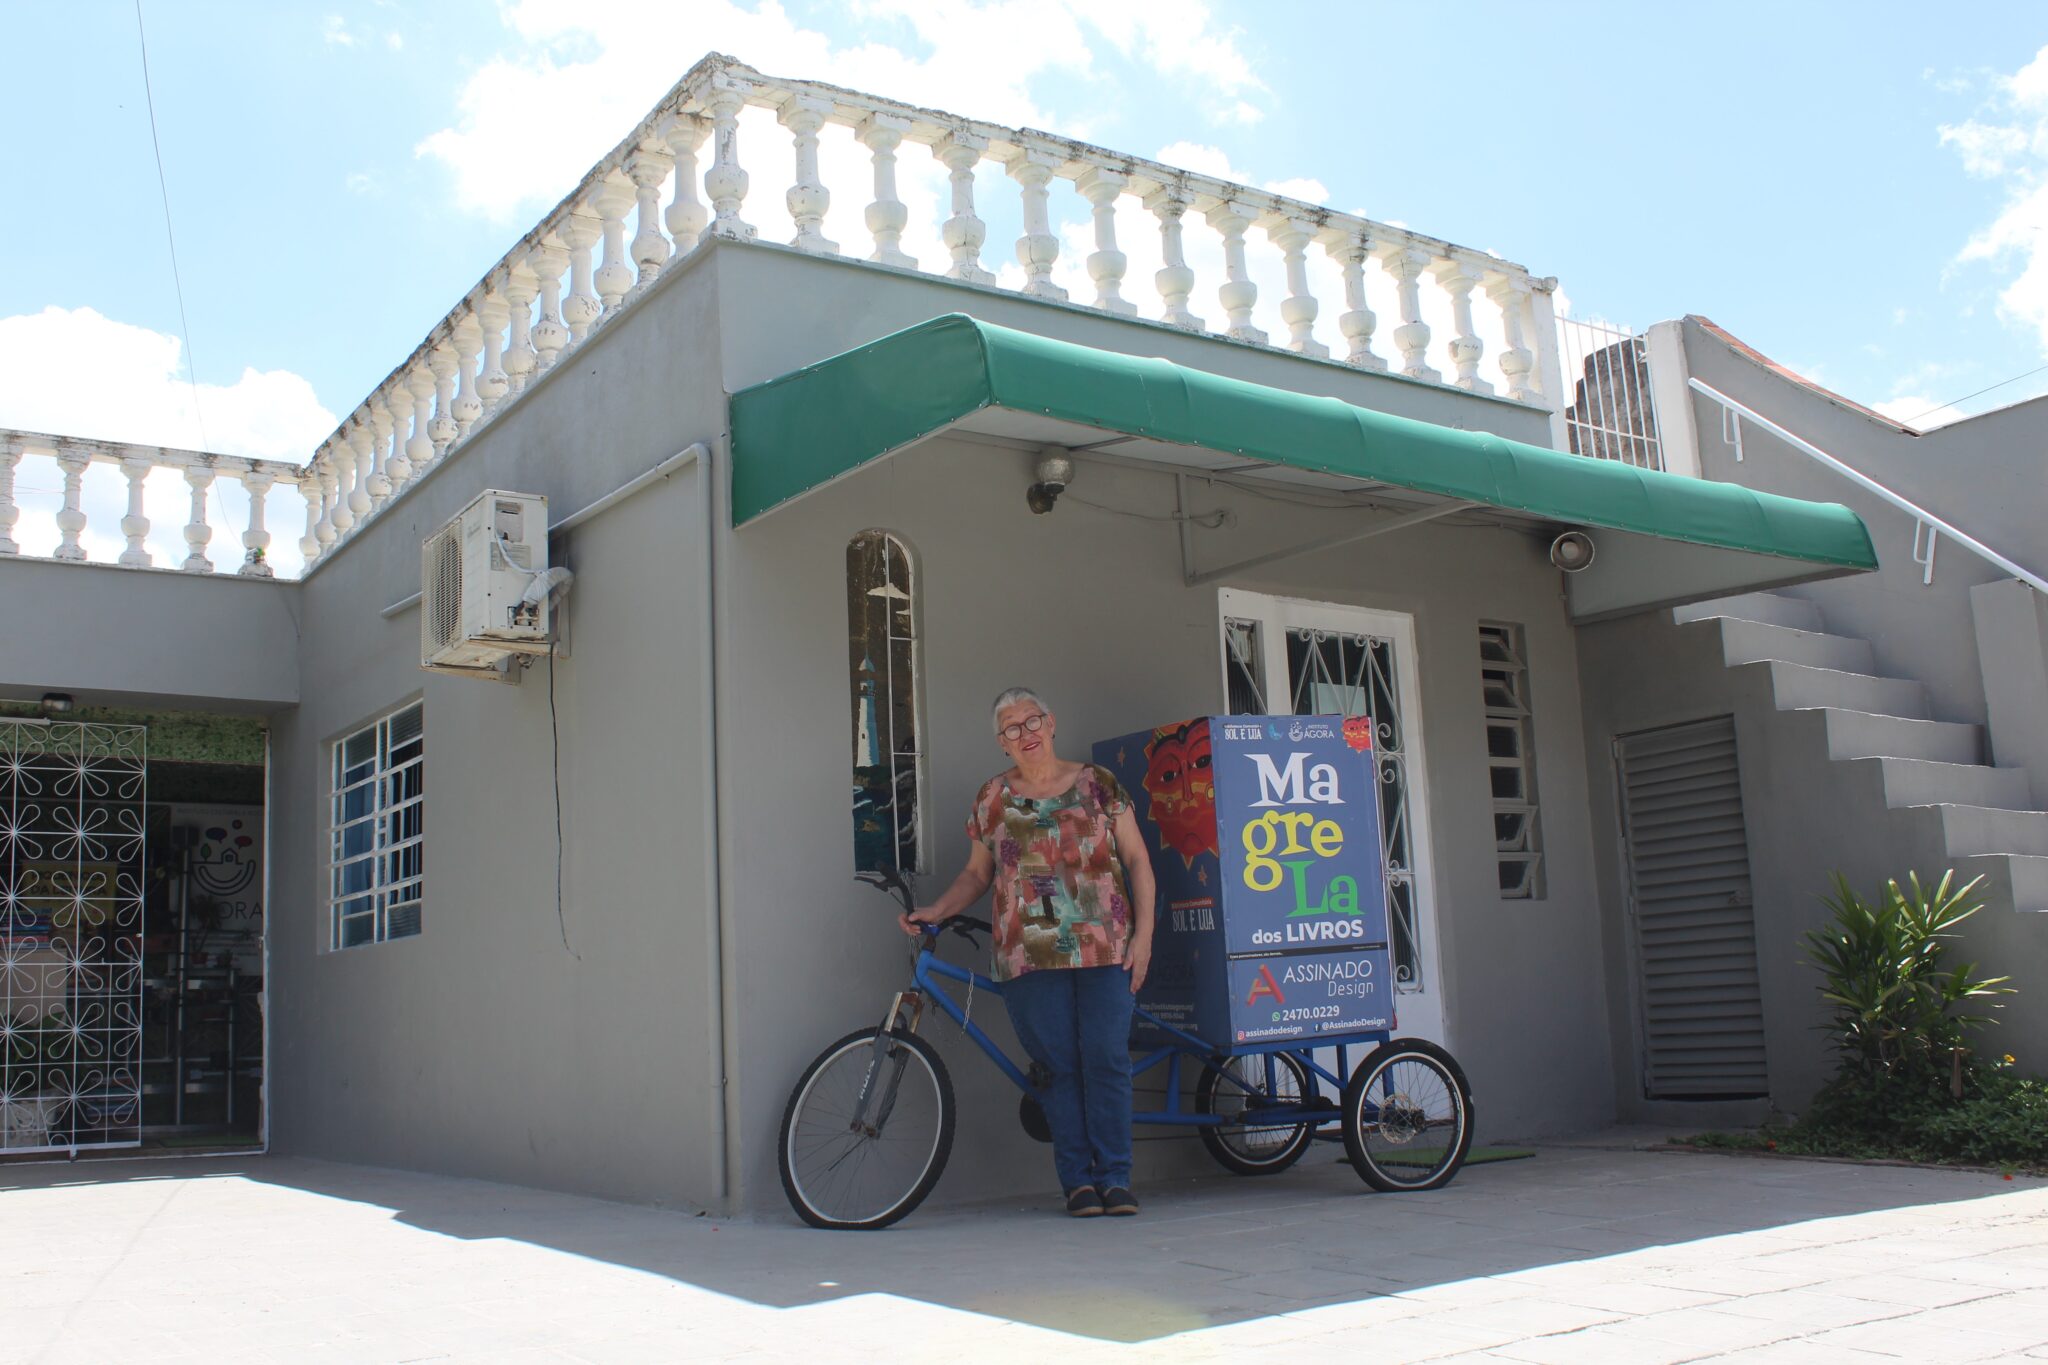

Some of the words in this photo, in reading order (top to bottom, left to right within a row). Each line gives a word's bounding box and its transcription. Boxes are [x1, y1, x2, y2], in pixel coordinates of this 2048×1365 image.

[1224, 728, 1238, 740] SOL
[1240, 728, 1246, 740] E
[1248, 728, 1262, 740] LUA
[1304, 728, 1334, 739] ÁGORA
[1243, 752, 1346, 807] Ma
[1242, 810, 1344, 891] gre
[1280, 860, 1366, 917] La
[1172, 910, 1188, 932] SOL
[1190, 909, 1196, 931] E
[1198, 908, 1215, 930] LUA
[1252, 929, 1282, 944] dos
[1286, 919, 1364, 942] LIVROS
[1283, 960, 1373, 984] ASSINADO
[1328, 979, 1374, 999] Design
[1282, 1005, 1340, 1022] 2470.0229
[1322, 1017, 1386, 1031] @AssinadoDesign
[1246, 1025, 1303, 1038] assinadodesign
